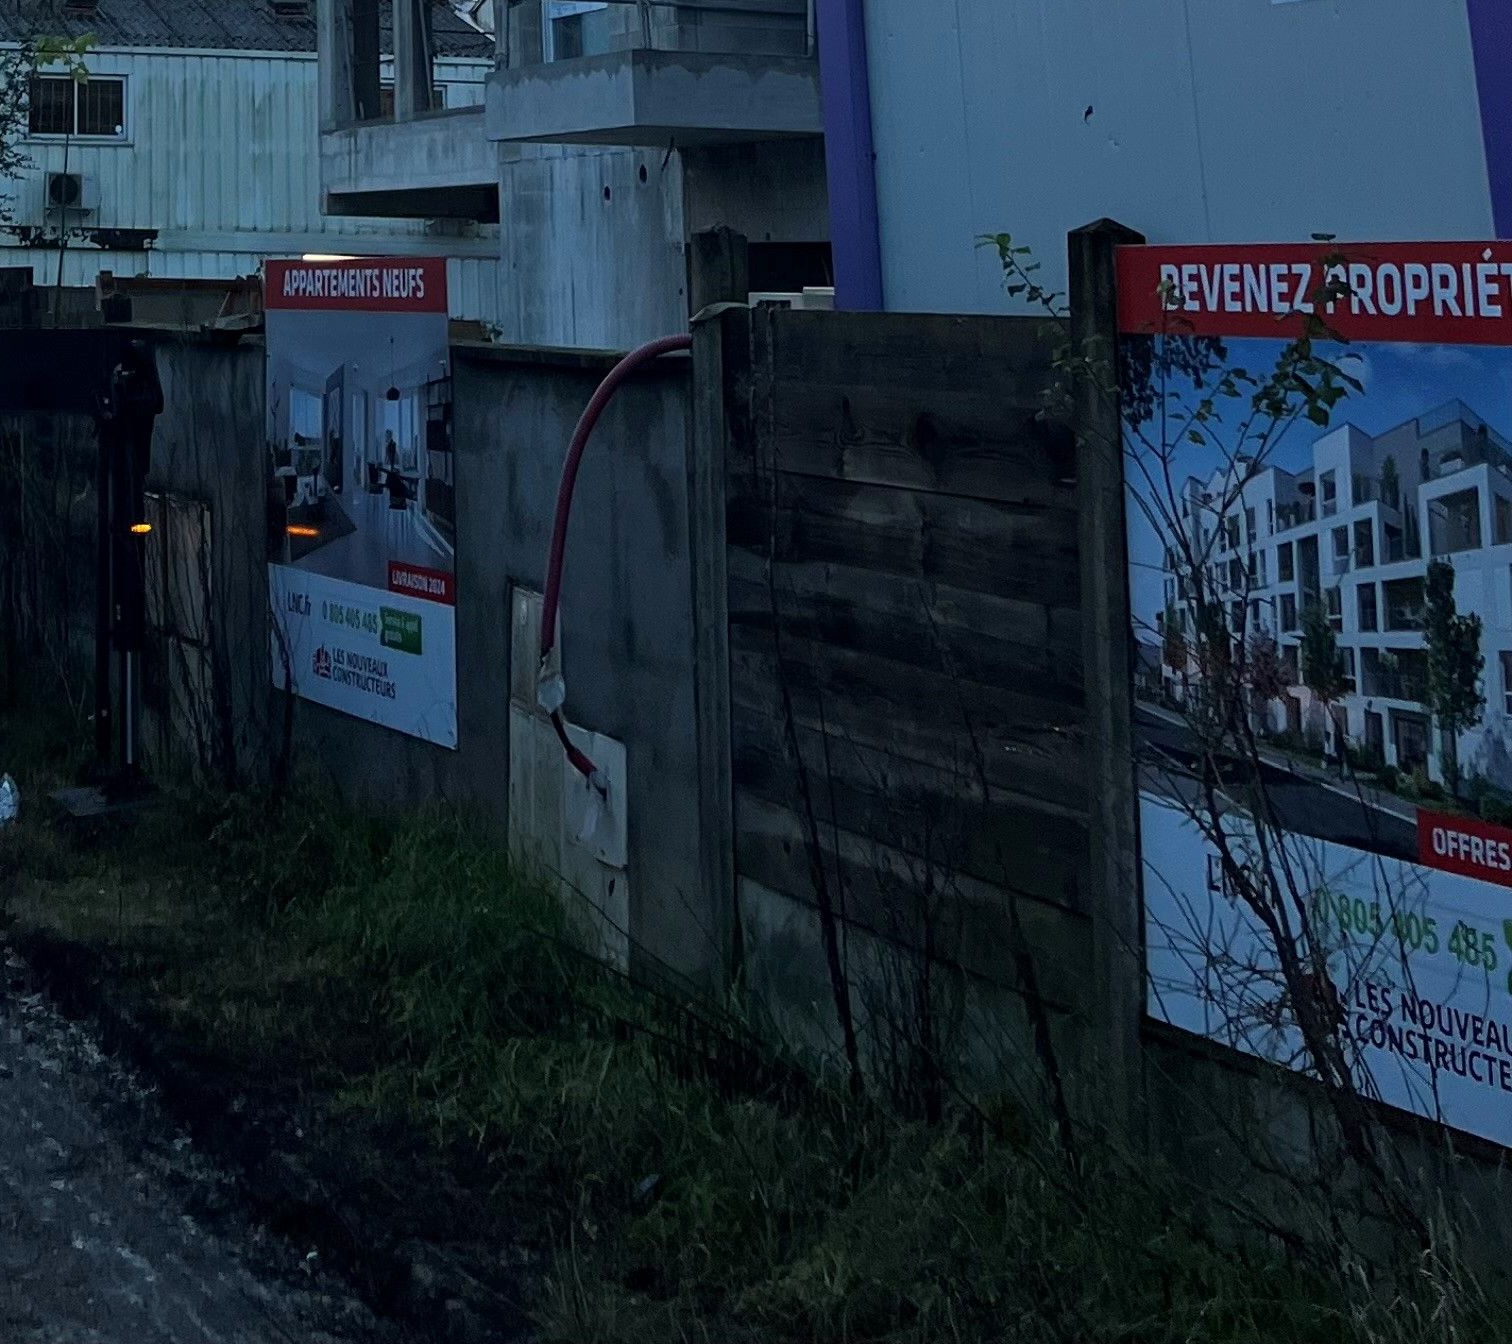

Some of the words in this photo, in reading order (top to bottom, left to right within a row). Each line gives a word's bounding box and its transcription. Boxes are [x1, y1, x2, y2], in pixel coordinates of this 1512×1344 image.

[283, 268, 380, 298] APPARTEMENTS
[383, 268, 424, 298] NEUFS
[1159, 262, 1314, 313] DEVENEZ
[332, 647, 345, 665] LES
[346, 651, 388, 678] NOUVEAUX
[332, 665, 396, 699] CONSTRUCTEURS
[1432, 827, 1511, 871] OFFRES
[1354, 979, 1394, 1017] LES
